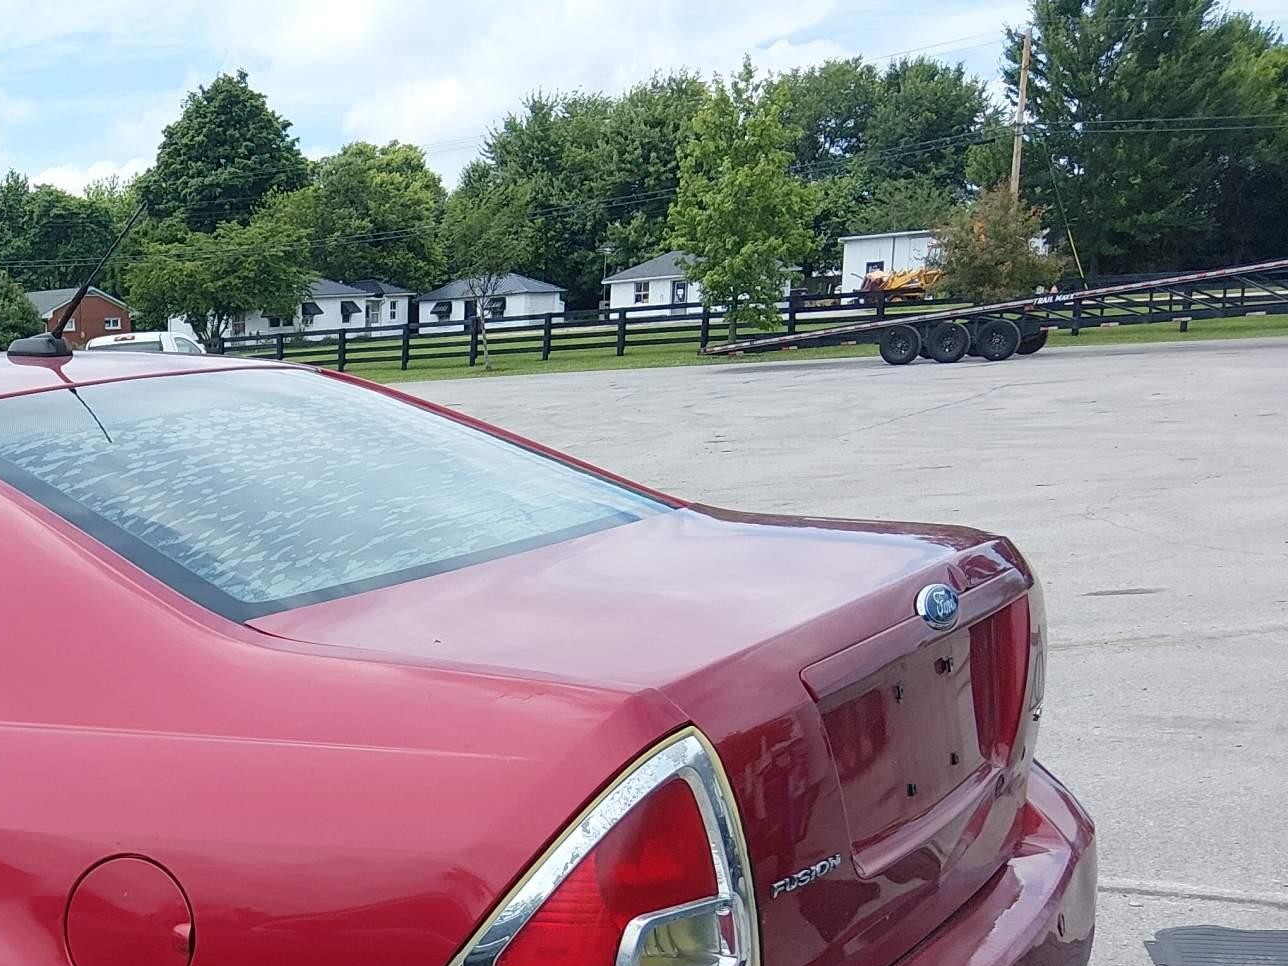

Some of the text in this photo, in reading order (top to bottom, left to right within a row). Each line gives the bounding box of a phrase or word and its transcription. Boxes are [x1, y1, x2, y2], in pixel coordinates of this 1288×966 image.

[1032, 295, 1054, 306] TRAIL
[932, 590, 957, 617] Ford
[771, 853, 841, 899] FUSION
